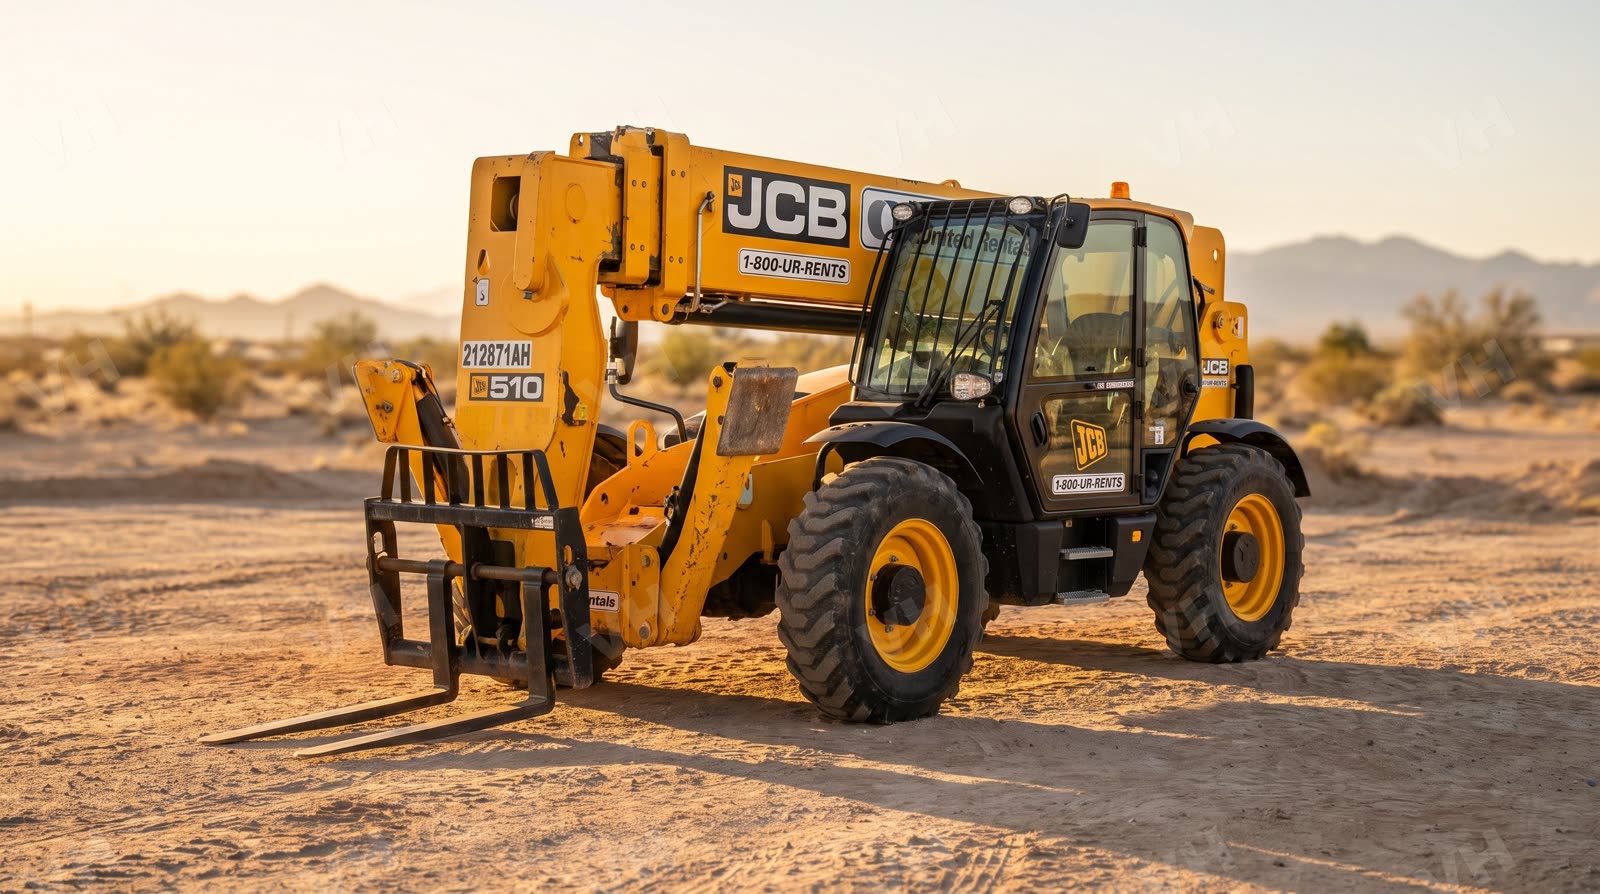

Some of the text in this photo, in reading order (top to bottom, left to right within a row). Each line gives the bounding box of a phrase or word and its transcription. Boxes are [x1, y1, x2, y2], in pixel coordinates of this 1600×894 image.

[728, 177, 847, 240] JCB
[743, 255, 846, 278] 1-800-UR-RENTS
[463, 343, 531, 366] 212871AH
[1203, 360, 1228, 374] JCB
[490, 376, 542, 399] 510
[1076, 425, 1105, 465] JCB
[1055, 477, 1123, 490] 1-800-UR-RENTS
[589, 596, 615, 608] ntals
